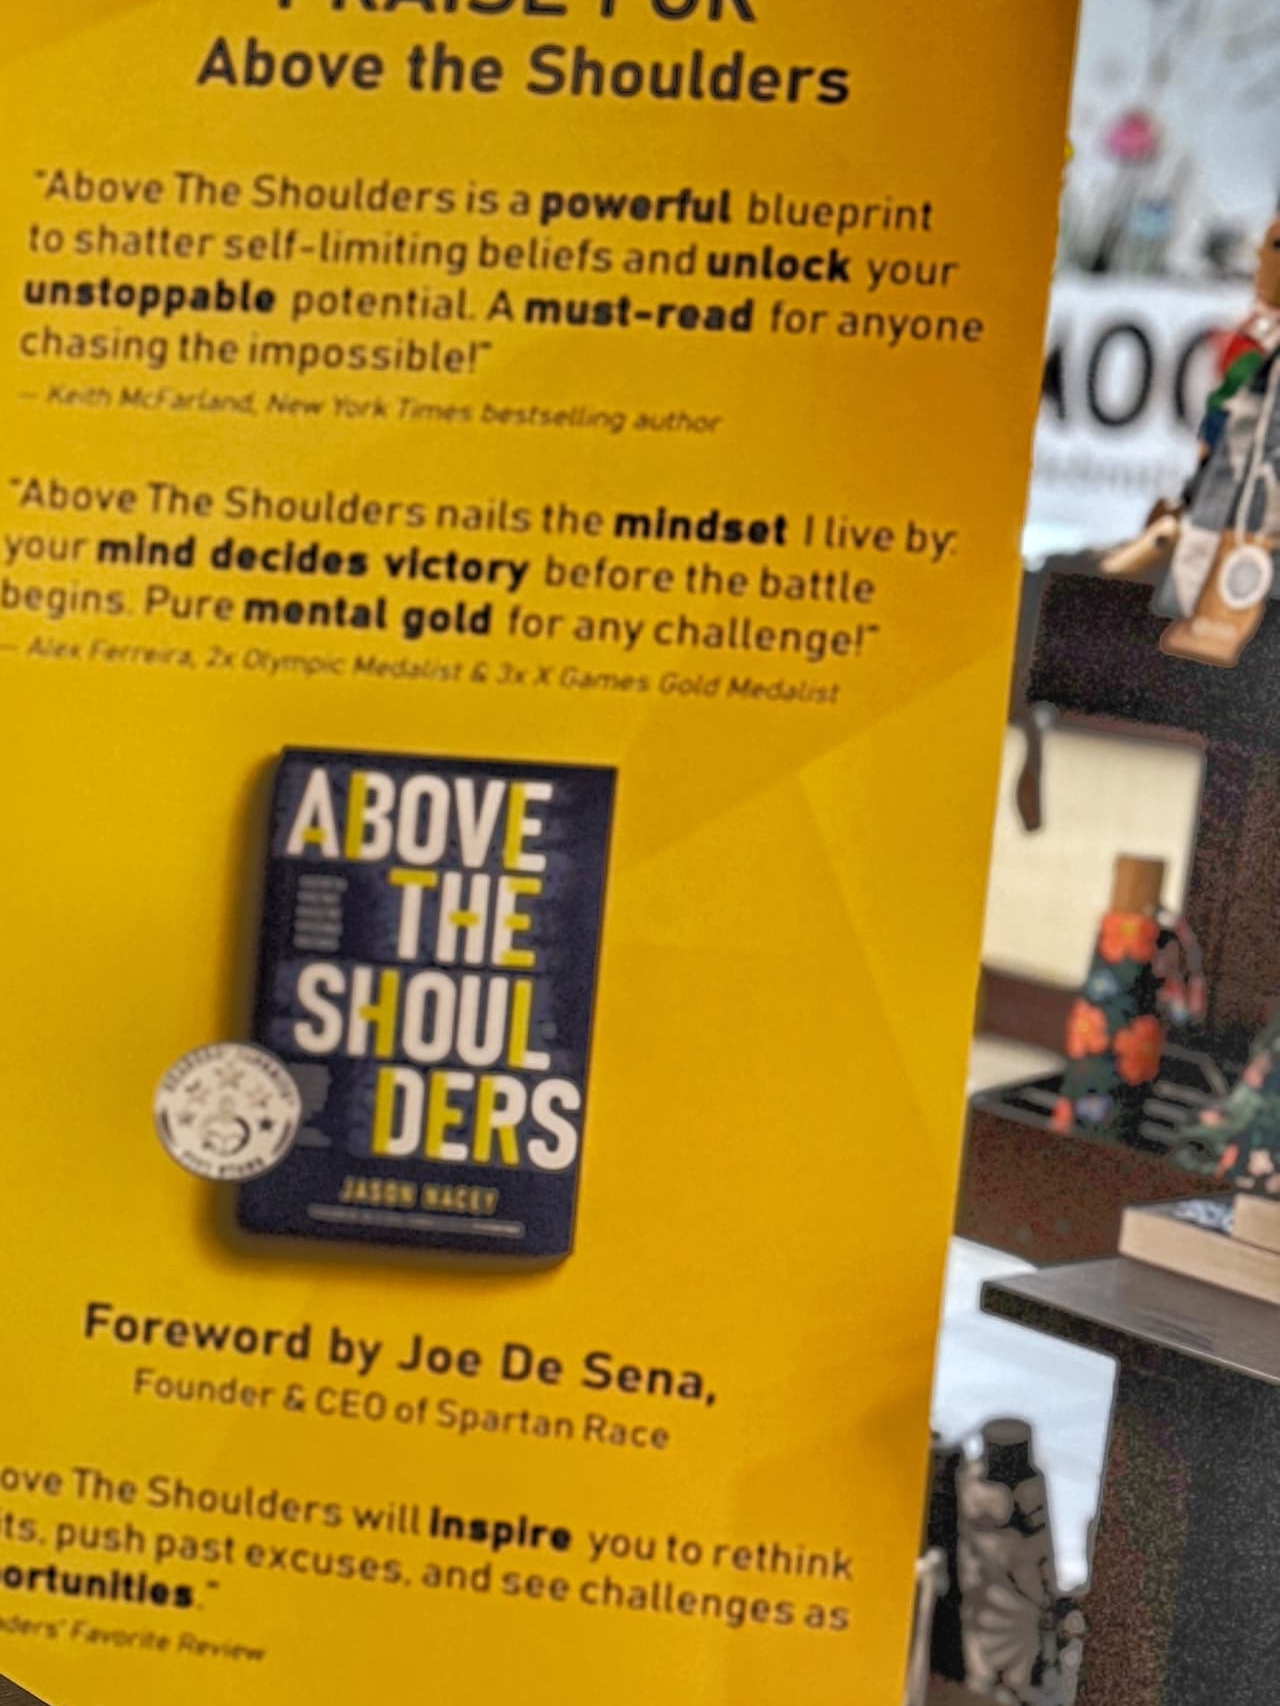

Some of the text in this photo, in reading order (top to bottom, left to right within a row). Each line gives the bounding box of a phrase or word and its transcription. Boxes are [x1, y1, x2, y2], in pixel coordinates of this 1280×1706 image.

[197, 37, 849, 105] Above the Shoulders
[176, 172, 240, 206] The
[254, 174, 455, 213] Shoulders
[467, 190, 498, 214] is
[509, 191, 530, 215] a
[539, 187, 731, 227] powerful
[748, 193, 932, 236] blueprint
[30, 225, 958, 292] to shatter self-limiting beliefs and unlock your
[24, 277, 983, 346] unstoppable potential. A must-read for anyone
[21, 325, 168, 370] chasing
[179, 331, 239, 364] the
[149, 483, 212, 516] The
[227, 487, 424, 526] Shoulders
[437, 501, 530, 531] nails
[543, 504, 603, 535] the
[614, 506, 787, 546] mindset
[805, 516, 813, 546] I
[826, 517, 894, 551] live
[3, 533, 874, 602] your mind decides victory before the battle
[2, 580, 132, 618] begins.
[146, 585, 233, 620] Pure
[243, 597, 386, 629] mental
[402, 601, 492, 641] gold
[510, 606, 562, 637] for
[574, 618, 643, 650] any
[285, 767, 554, 872] ABOVE
[388, 868, 542, 969] THE
[293, 961, 552, 1071] SHOUL
[371, 1066, 582, 1171] DERS
[341, 1177, 500, 1213] JASON NACEY
[85, 1302, 715, 1407] Foreword by Joe De Sena,
[134, 1367, 670, 1450] Founder & CEO of Spartan Race
[74, 1467, 136, 1503] The
[149, 1476, 341, 1527] Shoulders
[354, 1505, 418, 1535] will
[429, 1505, 572, 1553] inspire
[590, 1533, 655, 1562] you
[667, 1535, 702, 1565] to
[713, 1543, 850, 1578] rethink
[55, 1523, 145, 1553] push
[154, 1533, 235, 1565] past
[245, 1544, 410, 1586] excuses,
[421, 1562, 492, 1593] and
[501, 1572, 570, 1602] see
[579, 1575, 794, 1628] challenges
[804, 1604, 848, 1631] as
[70, 1620, 170, 1652] Favorite
[177, 1632, 266, 1661] Review
